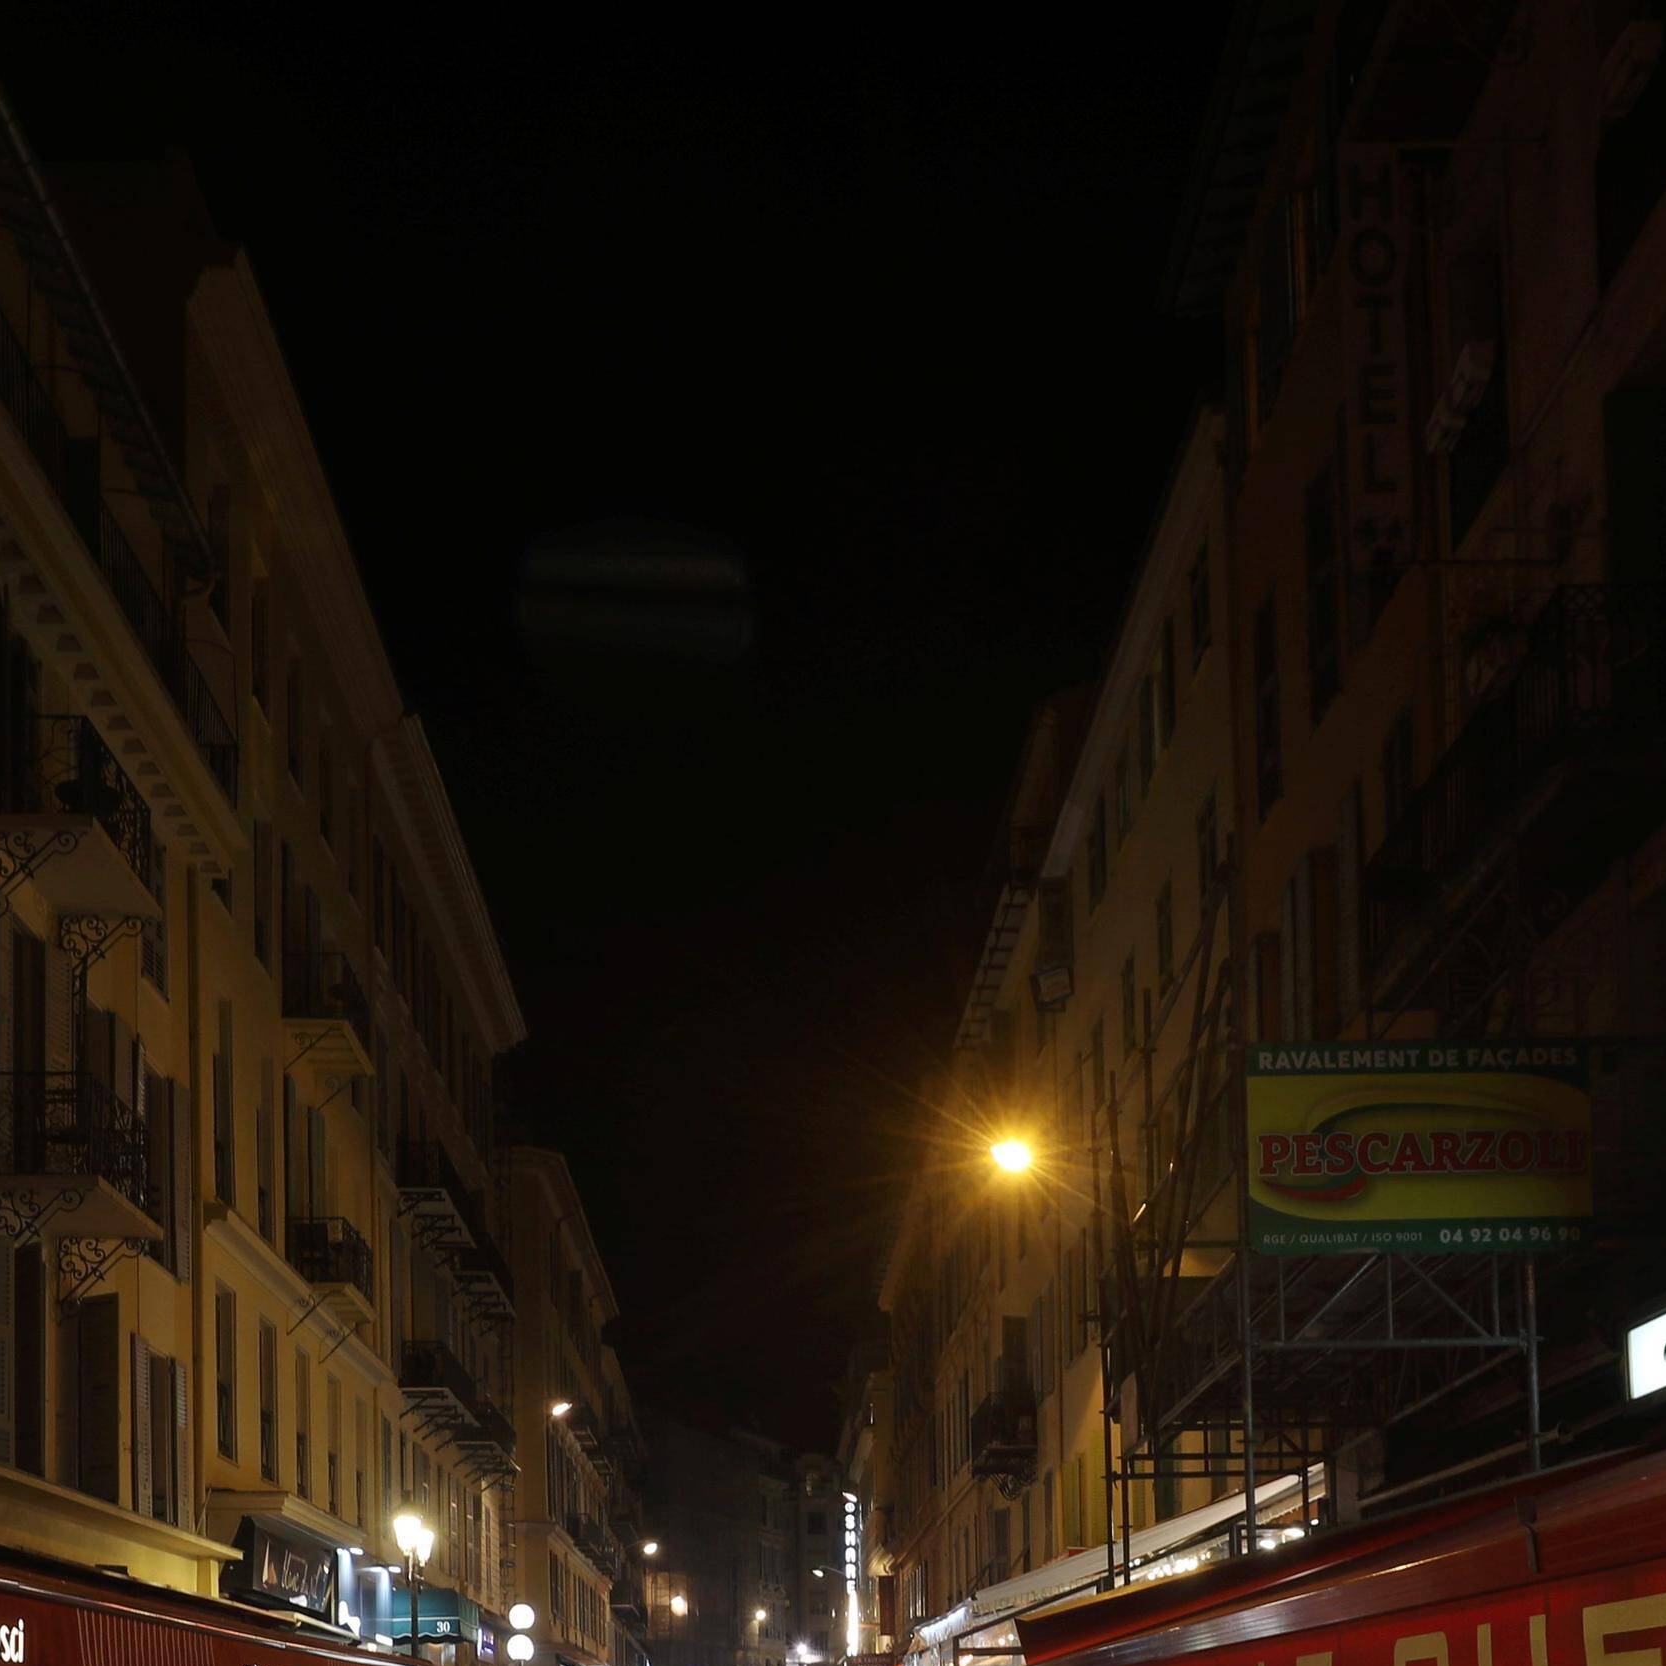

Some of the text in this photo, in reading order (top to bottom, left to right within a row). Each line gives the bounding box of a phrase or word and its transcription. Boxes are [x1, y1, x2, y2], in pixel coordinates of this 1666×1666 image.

[1349, 160, 1397, 494] HOTEL
[1258, 1047, 1579, 1072] RAVALEMENT DE FAÇADES
[1257, 1131, 1587, 1176] PESCARZOLI
[1263, 1233, 1287, 1245] RGE
[1299, 1232, 1359, 1245] QUALIBAT
[1371, 1232, 1394, 1243] ISO
[1396, 1232, 1423, 1243] 9001
[1439, 1229, 1464, 1244] 04
[1471, 1229, 1493, 1243] 92
[1498, 1228, 1523, 1243] 04
[1529, 1227, 1552, 1242] 96
[1558, 1227, 1582, 1242] 90
[436, 1620, 451, 1634] 30
